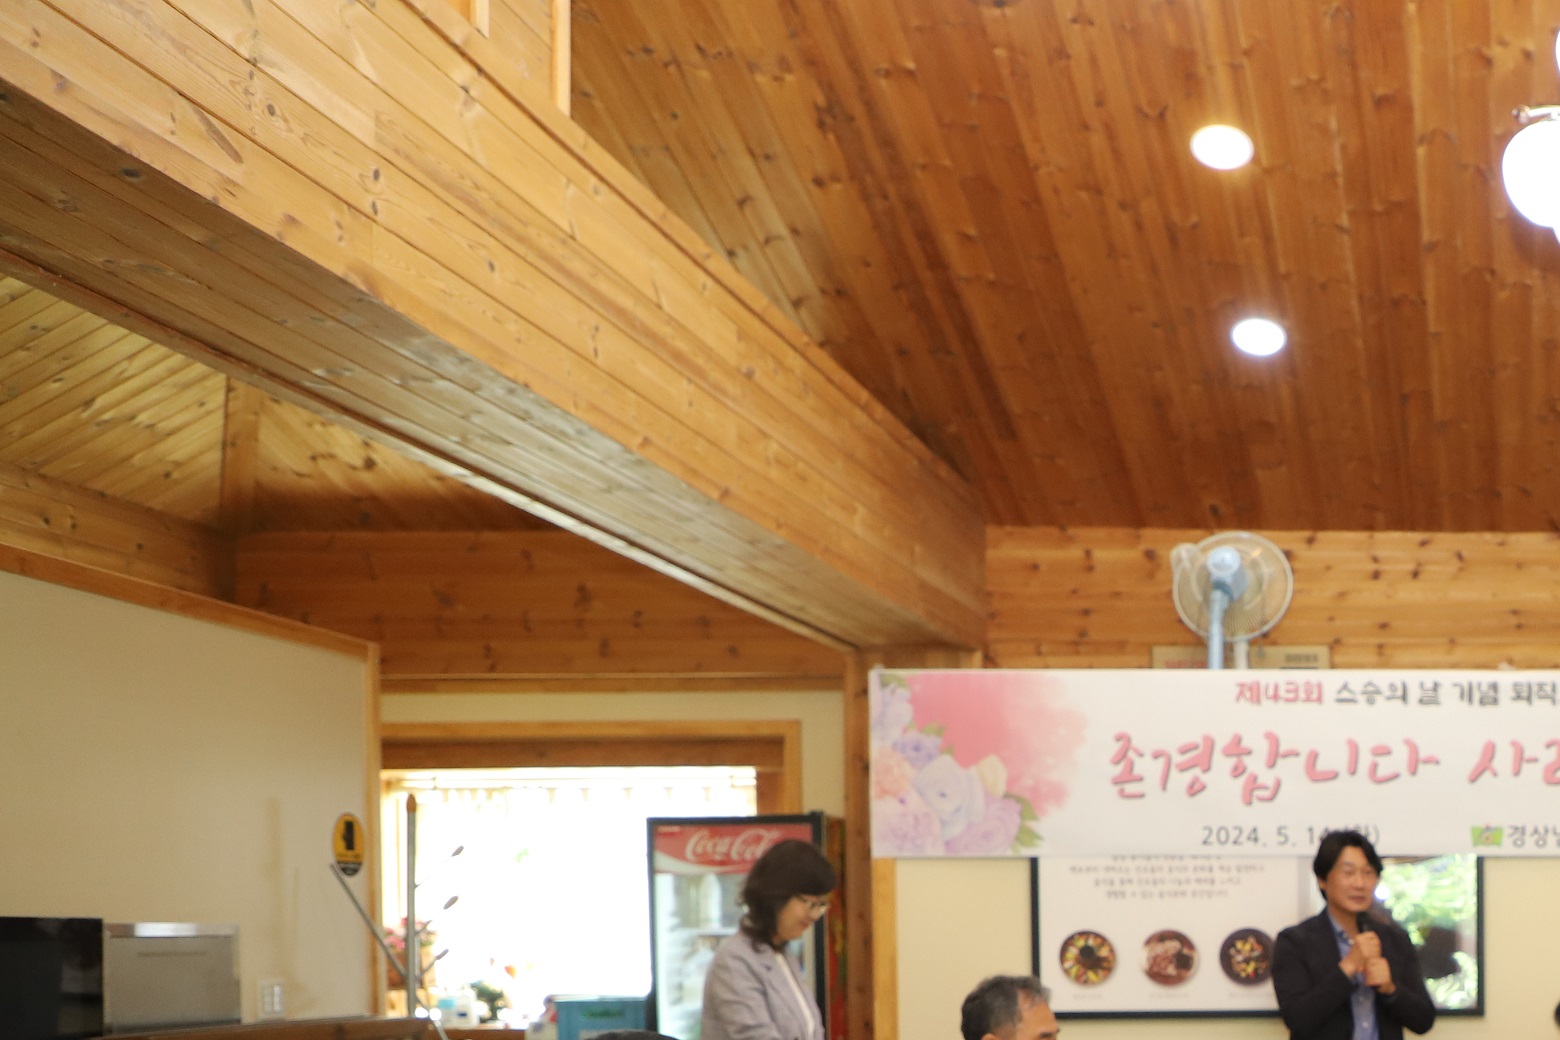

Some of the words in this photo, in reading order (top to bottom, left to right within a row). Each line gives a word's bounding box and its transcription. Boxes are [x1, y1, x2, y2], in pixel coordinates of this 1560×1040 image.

[1234, 680, 1323, 705] 제43회
[1335, 680, 1409, 706] 스승의
[1418, 681, 1441, 706] 날
[1453, 681, 1499, 706] 기념
[1110, 731, 1440, 806] 존경합니다
[1201, 825, 1266, 847] 2024.
[1276, 825, 1297, 847] 5.
